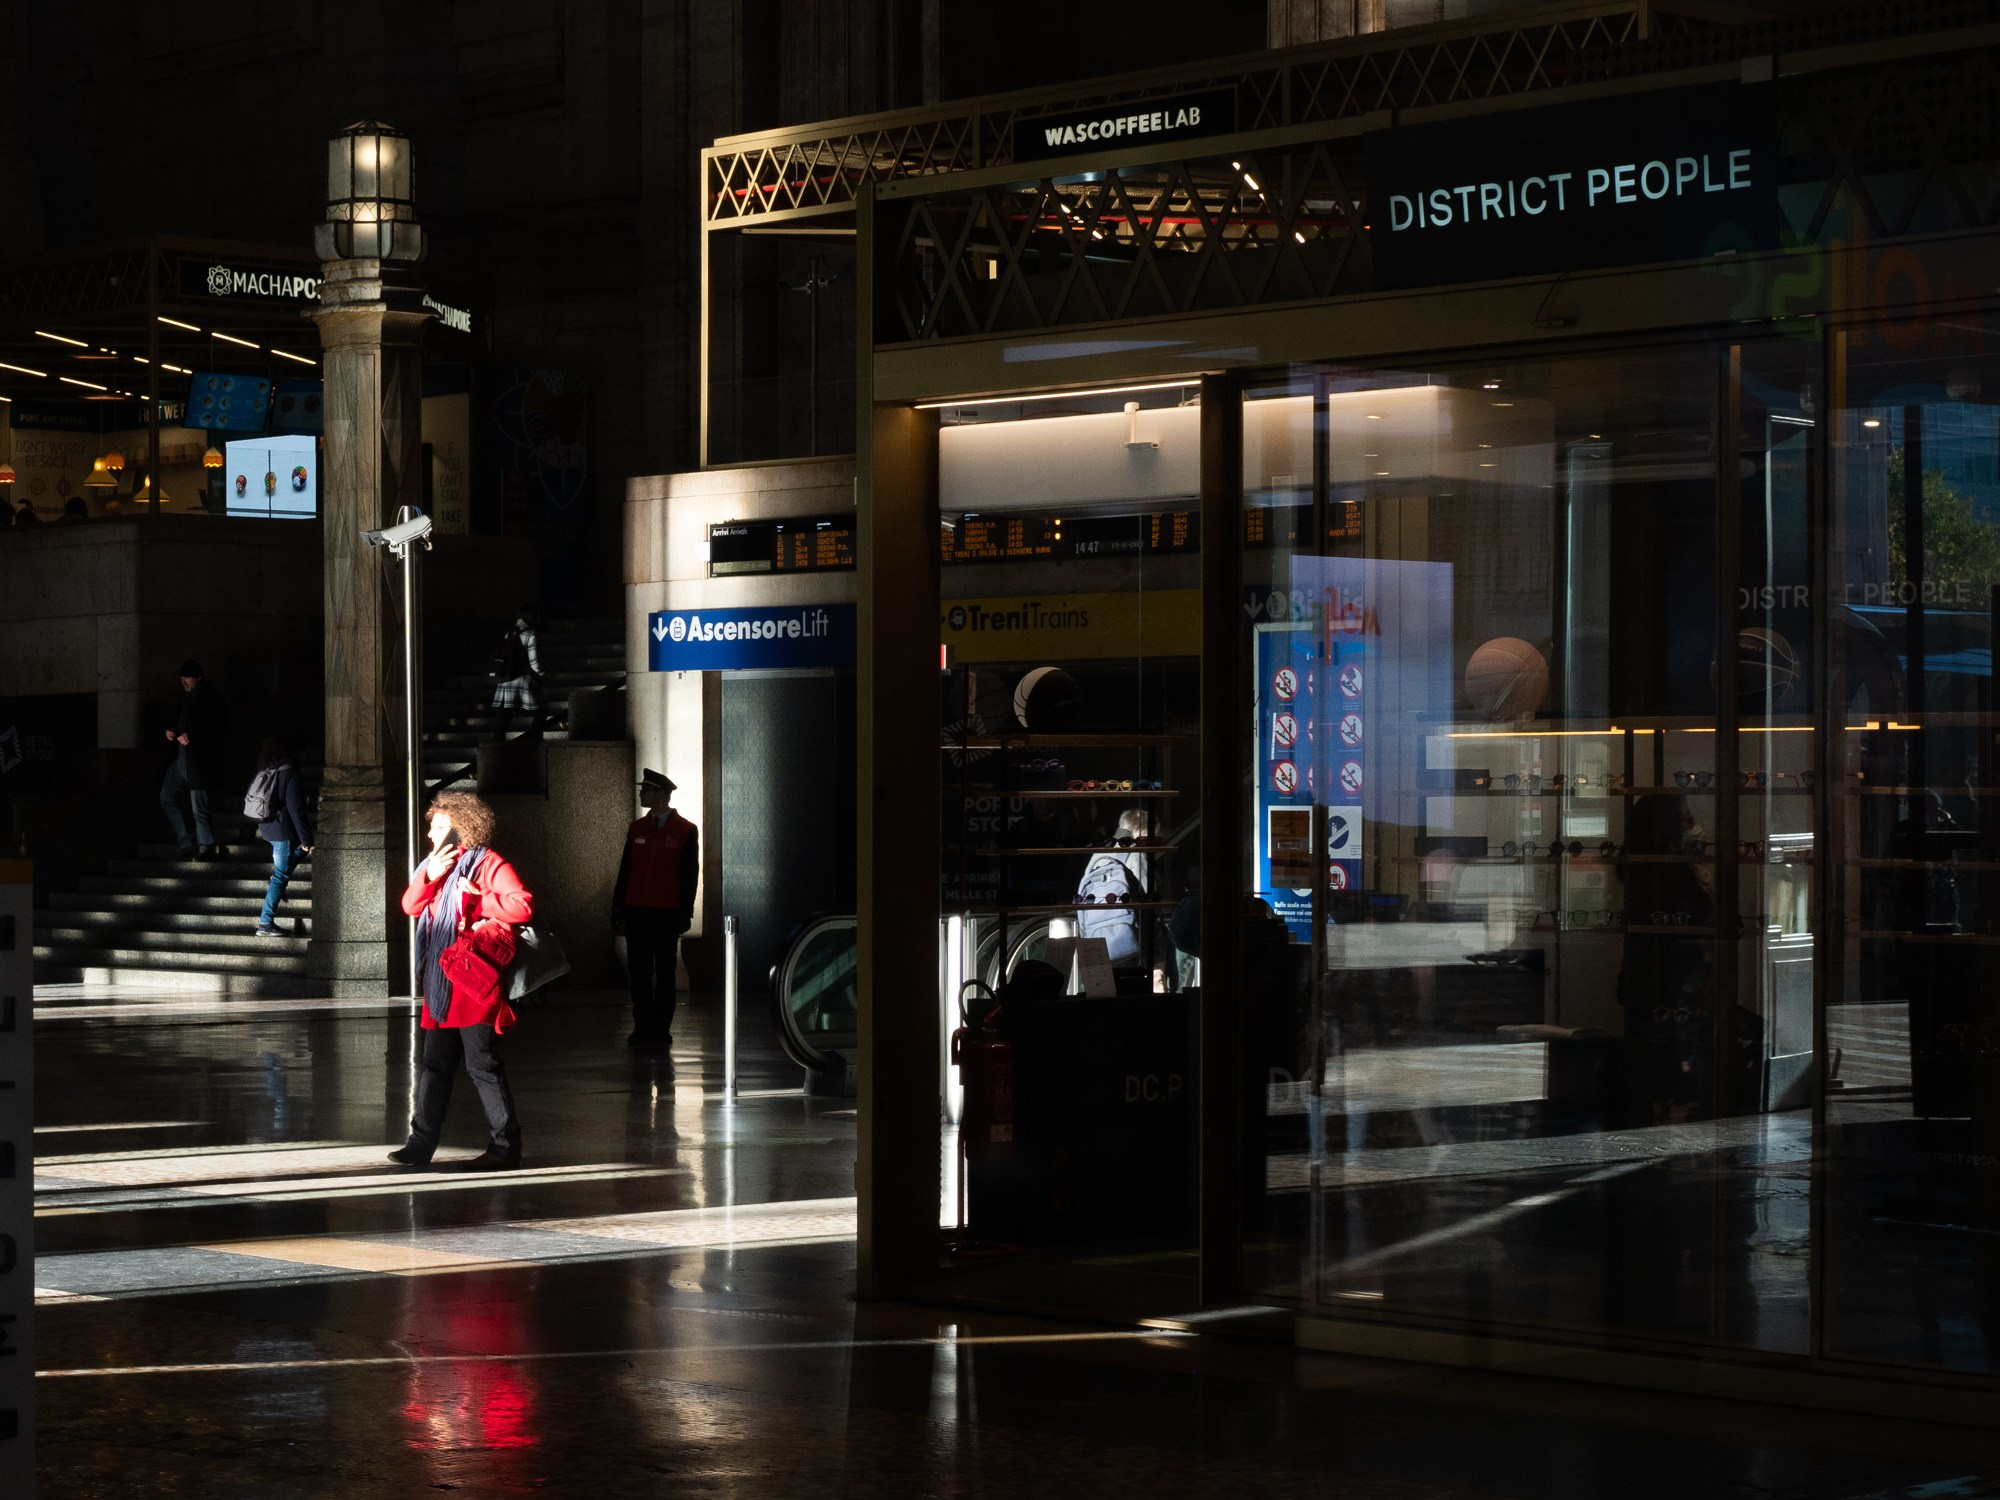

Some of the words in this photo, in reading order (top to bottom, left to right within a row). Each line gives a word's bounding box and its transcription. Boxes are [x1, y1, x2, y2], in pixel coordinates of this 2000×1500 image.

[1389, 172, 1572, 232] DISTRICT
[1587, 148, 1752, 208] PEOPLE
[16, 439, 47, 453] DON'T
[49, 442, 88, 455] WORRY
[25, 455, 37, 467] BE
[442, 457, 460, 471] YOU
[439, 472, 463, 488] CAN'T
[440, 509, 462, 523] TAKE
[712, 528, 729, 537] Arrivi
[1863, 579, 1972, 607] PEOPLE
[952, 873, 1001, 884] APRIRE
[945, 888, 982, 900] NELLE
